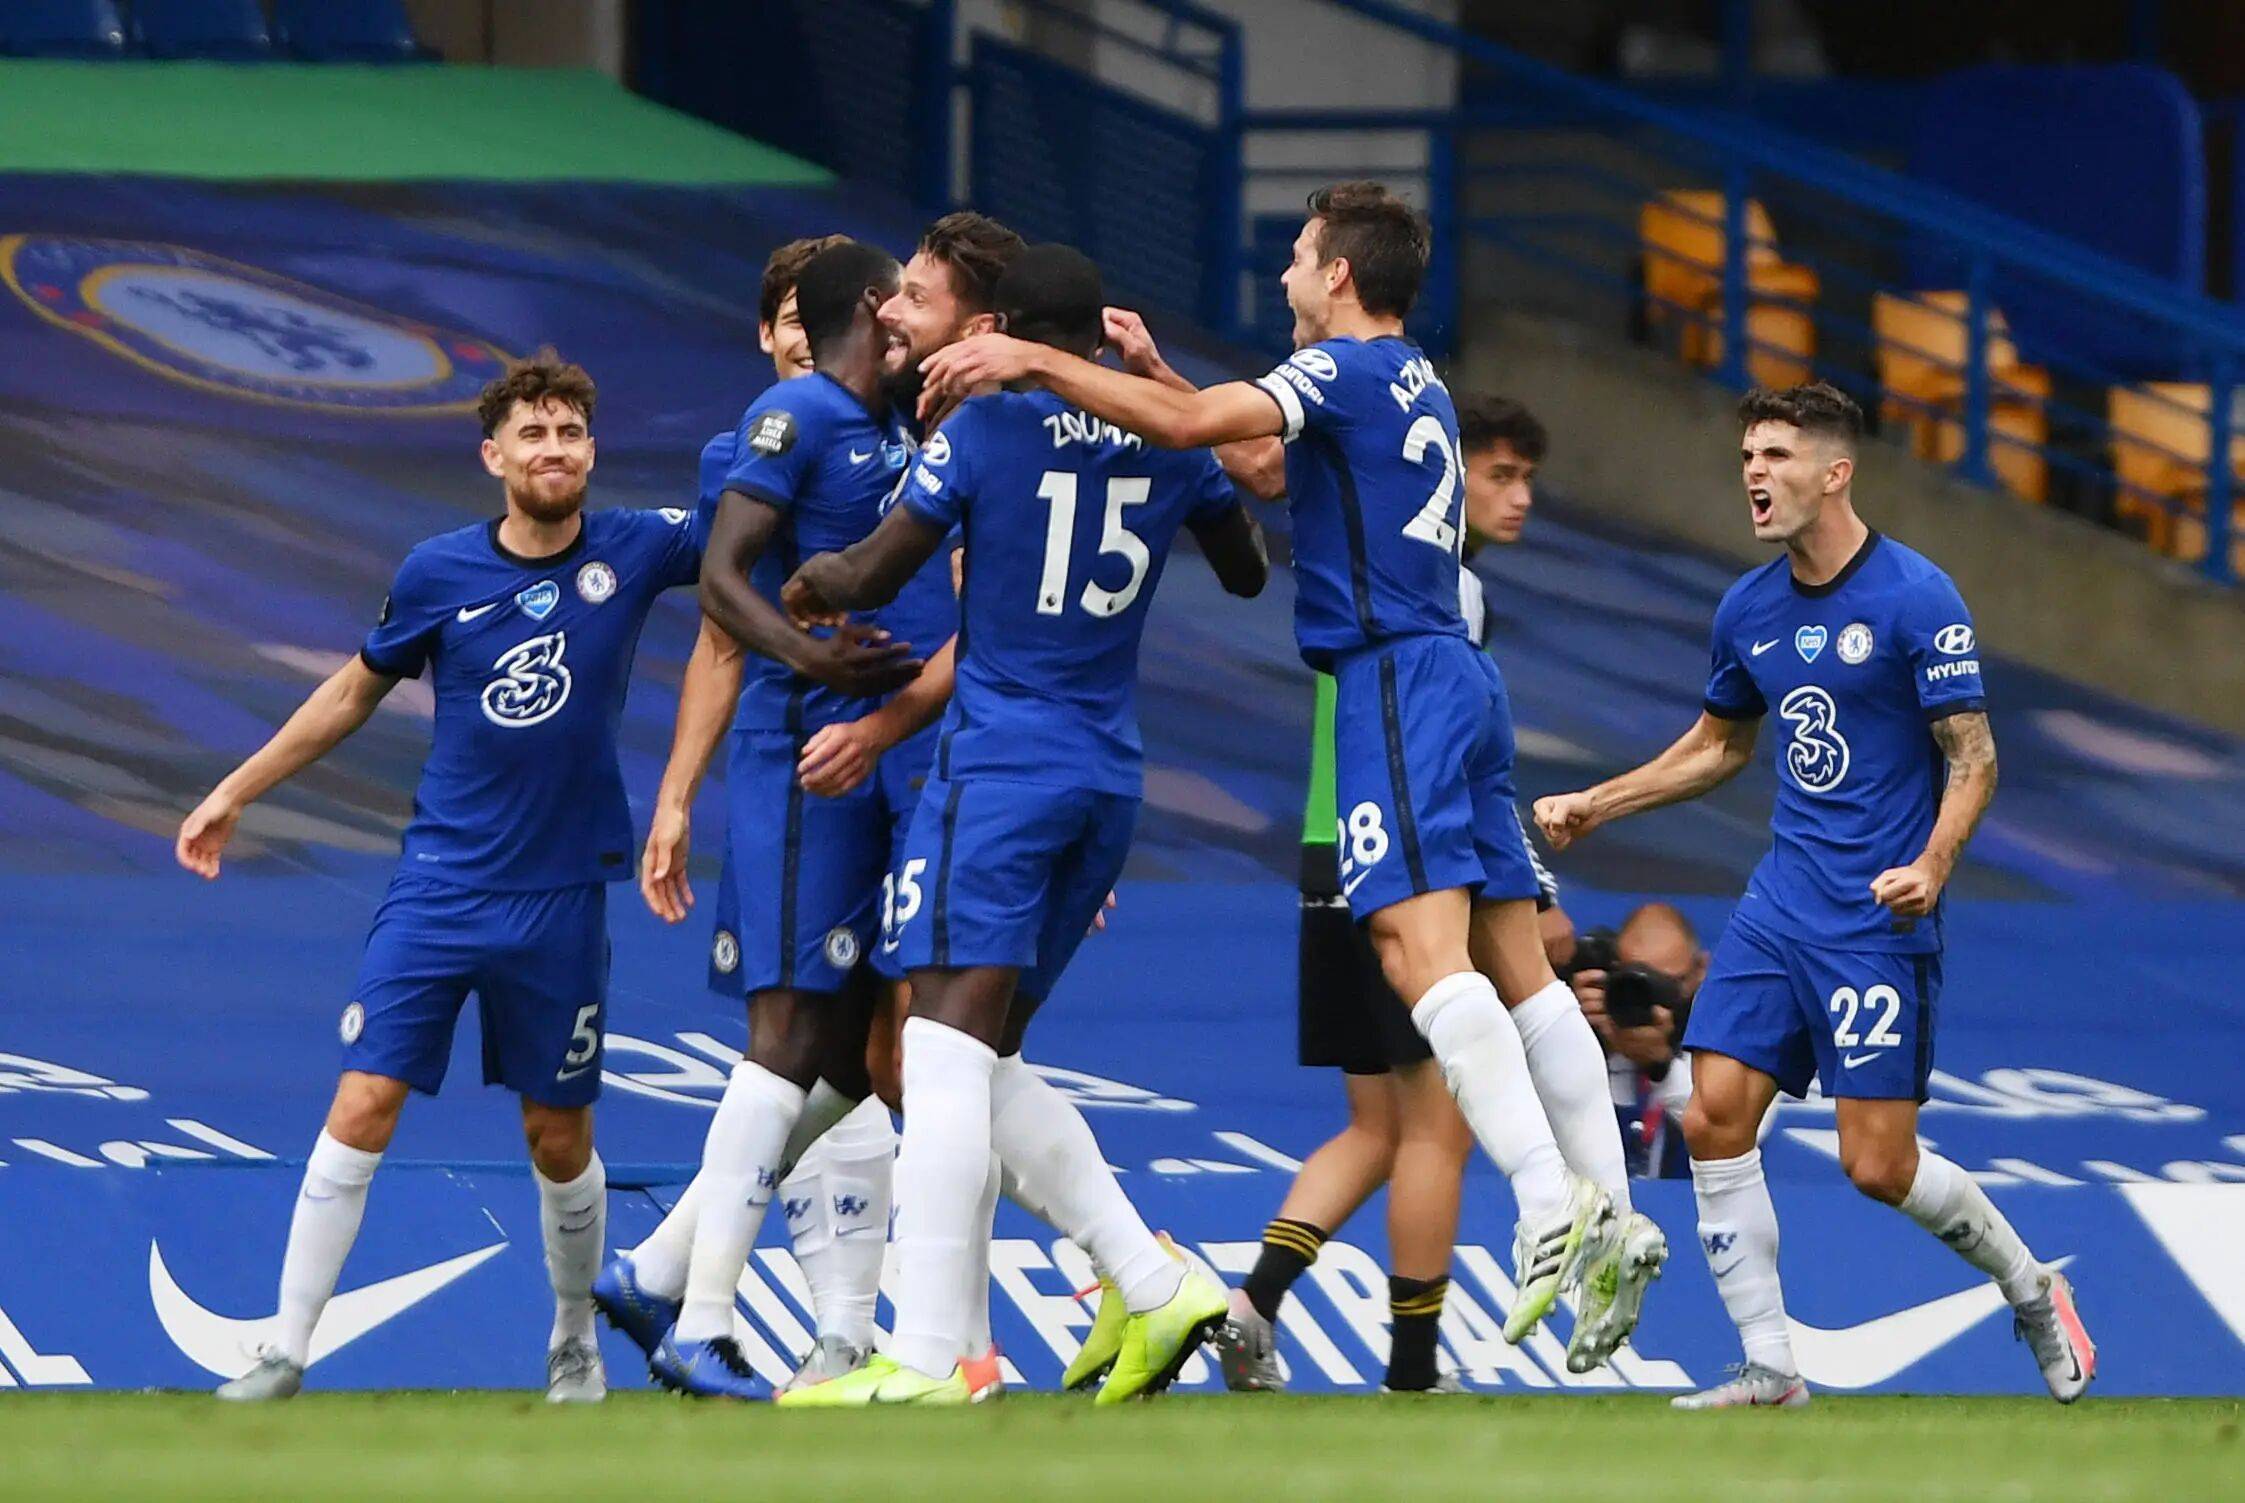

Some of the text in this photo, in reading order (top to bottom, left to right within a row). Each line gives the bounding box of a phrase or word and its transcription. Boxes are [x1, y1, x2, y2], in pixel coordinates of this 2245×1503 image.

[1036, 470, 1152, 618] 15
[882, 858, 927, 934] 15
[565, 1003, 600, 1065] 5
[1829, 984, 1903, 1048] 22
